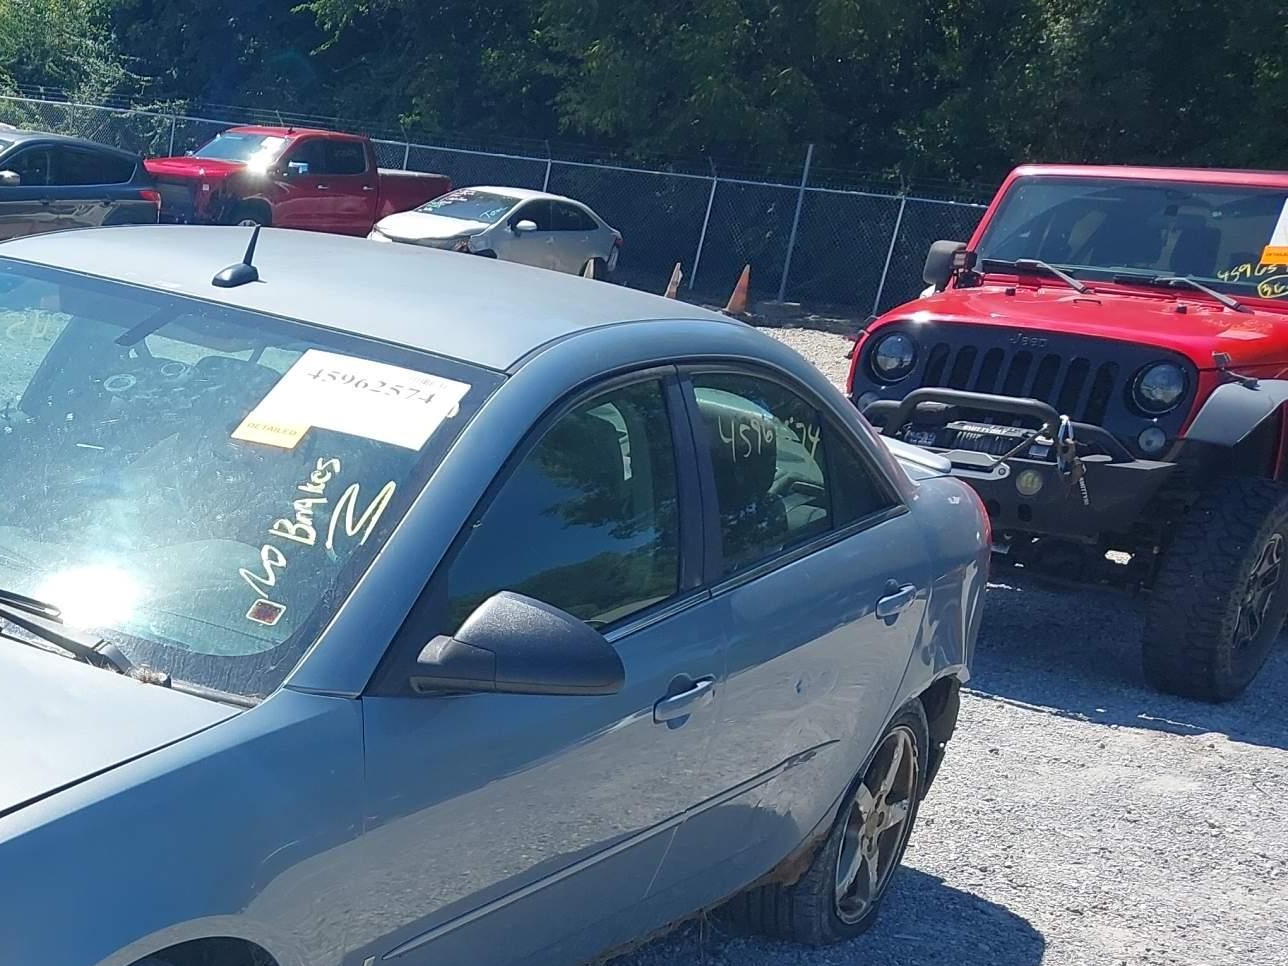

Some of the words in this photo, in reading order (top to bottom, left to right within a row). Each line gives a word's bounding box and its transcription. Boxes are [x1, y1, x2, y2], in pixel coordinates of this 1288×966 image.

[307, 367, 436, 406] 45962574
[247, 422, 298, 437] DETAILED
[717, 415, 822, 463] 459674
